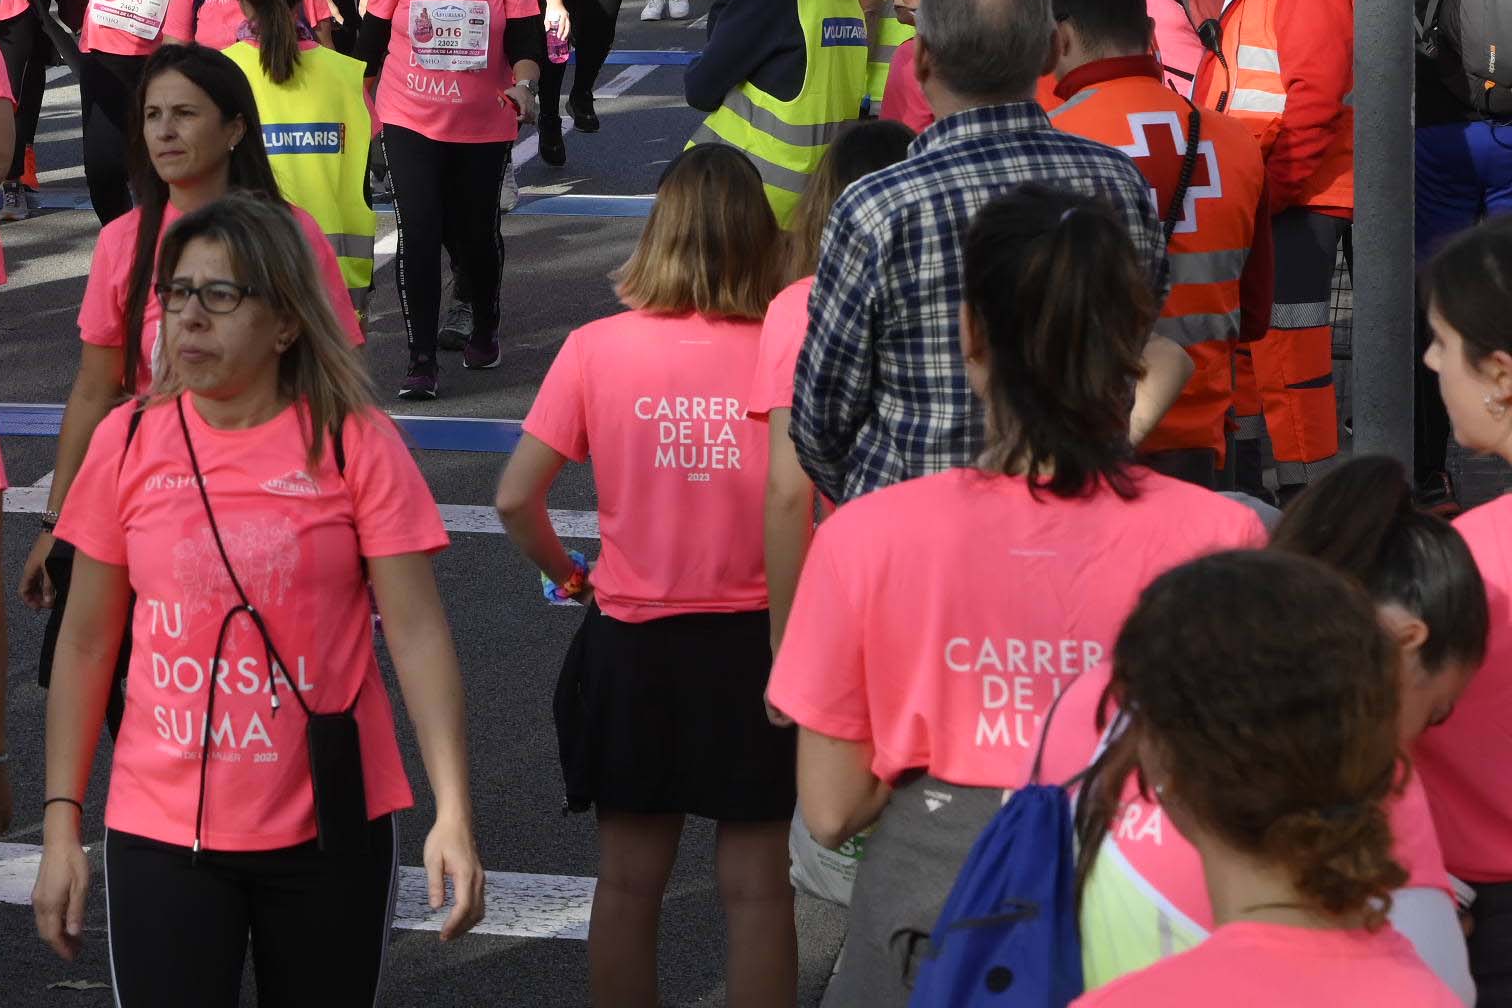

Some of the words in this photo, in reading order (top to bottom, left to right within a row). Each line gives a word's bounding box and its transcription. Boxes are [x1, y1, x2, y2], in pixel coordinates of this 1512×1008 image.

[435, 27, 462, 37] 016
[437, 39, 459, 47] 23023
[407, 73, 461, 97] SUMA
[262, 130, 339, 148] LUNTARIS
[659, 422, 693, 444] DE
[703, 421, 737, 444] LA
[654, 446, 742, 469] MUJER
[687, 473, 710, 482] 2023
[147, 599, 184, 638] TU
[945, 637, 1104, 675] CARRER
[152, 654, 315, 694] DORSAL
[983, 675, 1034, 711] DE
[154, 703, 272, 749] SUMA
[253, 752, 278, 763] 2023
